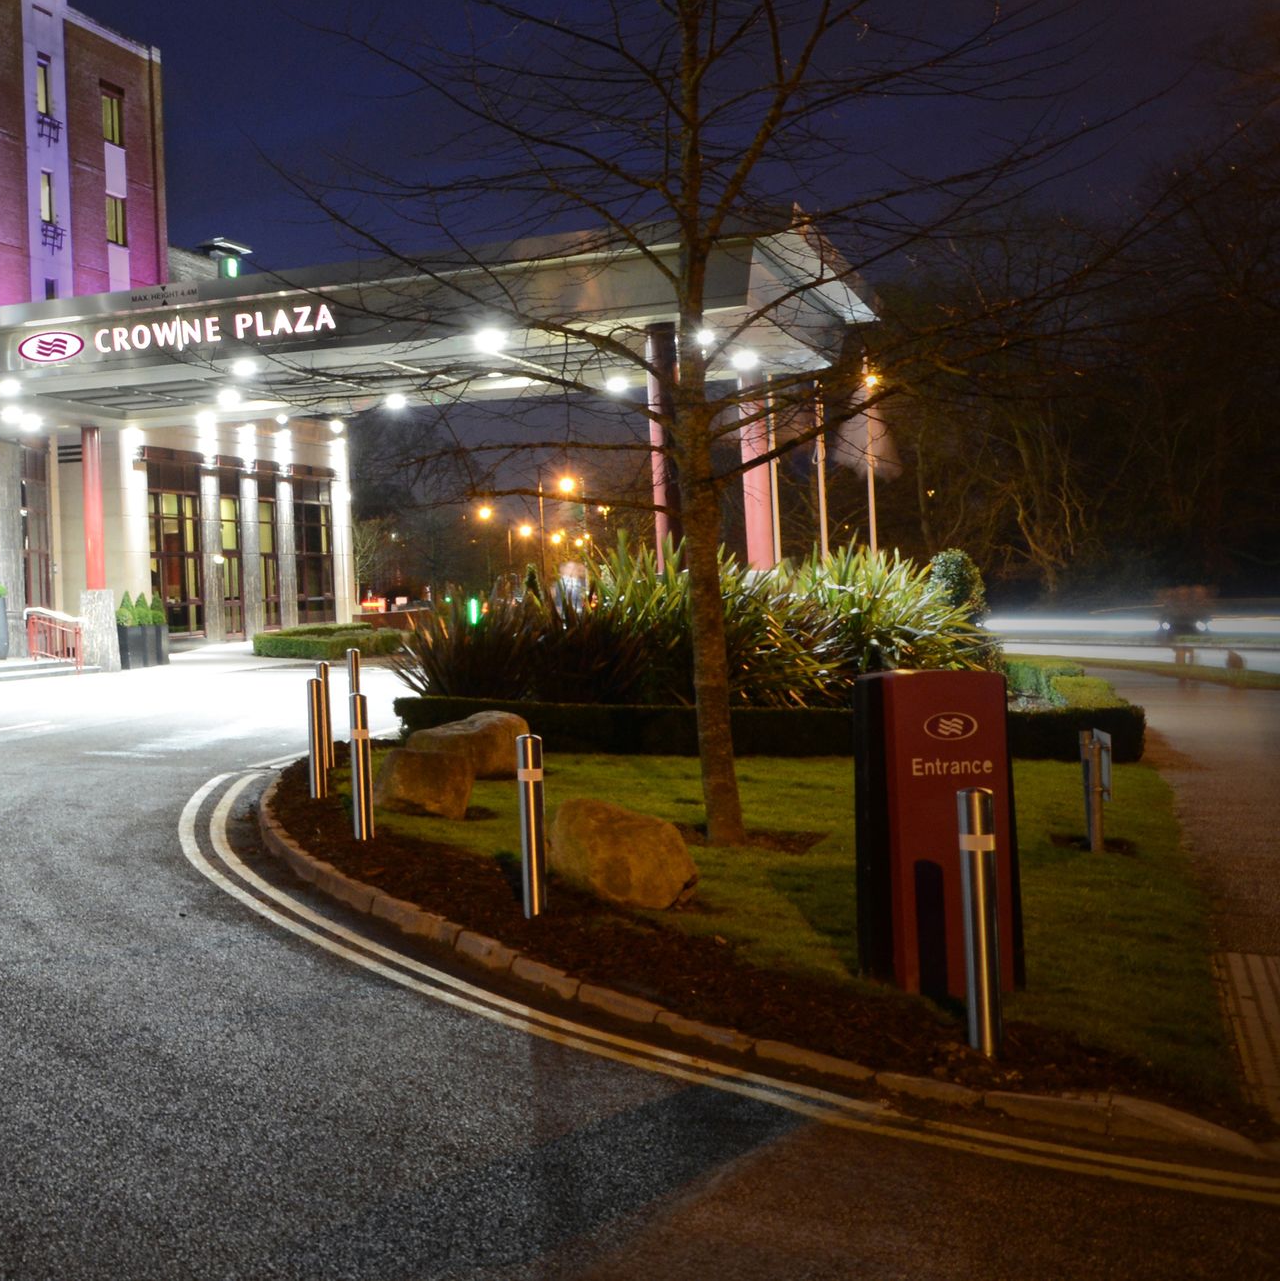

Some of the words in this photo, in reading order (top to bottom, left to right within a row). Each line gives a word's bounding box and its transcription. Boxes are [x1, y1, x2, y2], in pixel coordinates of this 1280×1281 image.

[151, 290, 178, 300] HEIGHT
[94, 317, 221, 353] CROWNE
[235, 304, 336, 339] PLAZA
[911, 758, 993, 776] Entrance
